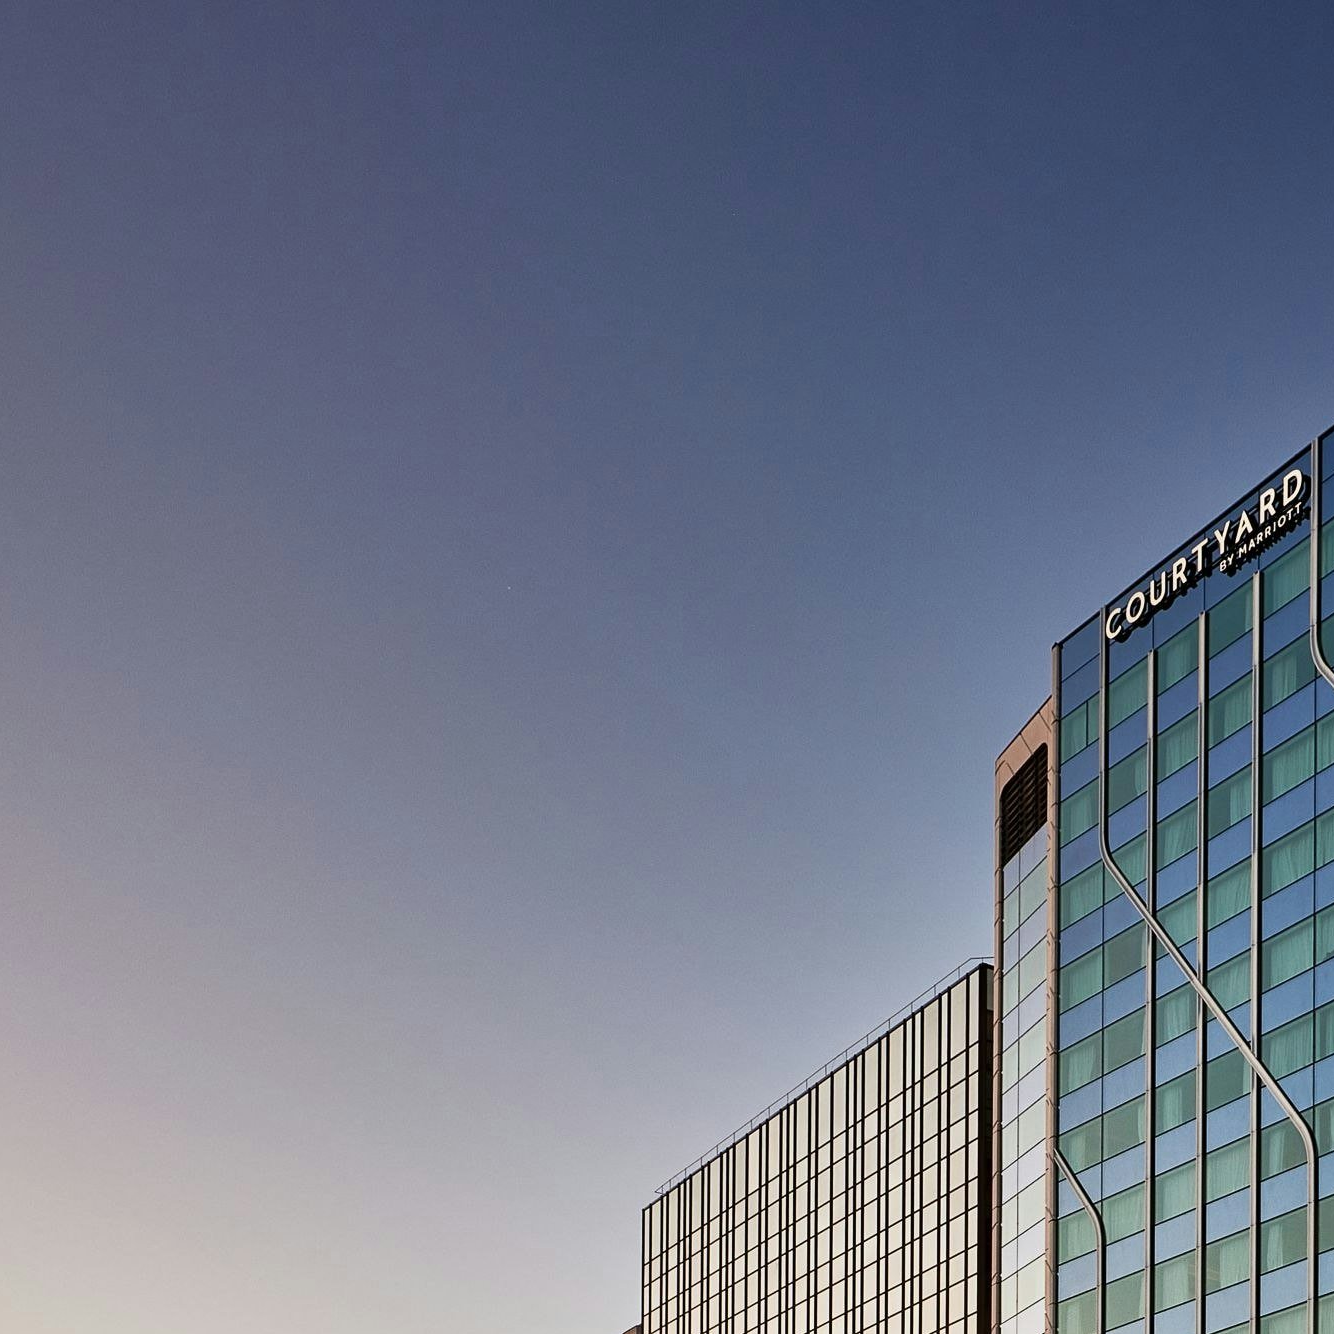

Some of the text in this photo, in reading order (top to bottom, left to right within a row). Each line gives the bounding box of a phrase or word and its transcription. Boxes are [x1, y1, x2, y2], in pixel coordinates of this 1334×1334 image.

[1105, 468, 1304, 640] COURTYARD
[1219, 501, 1303, 572] BY MARRIOTT
